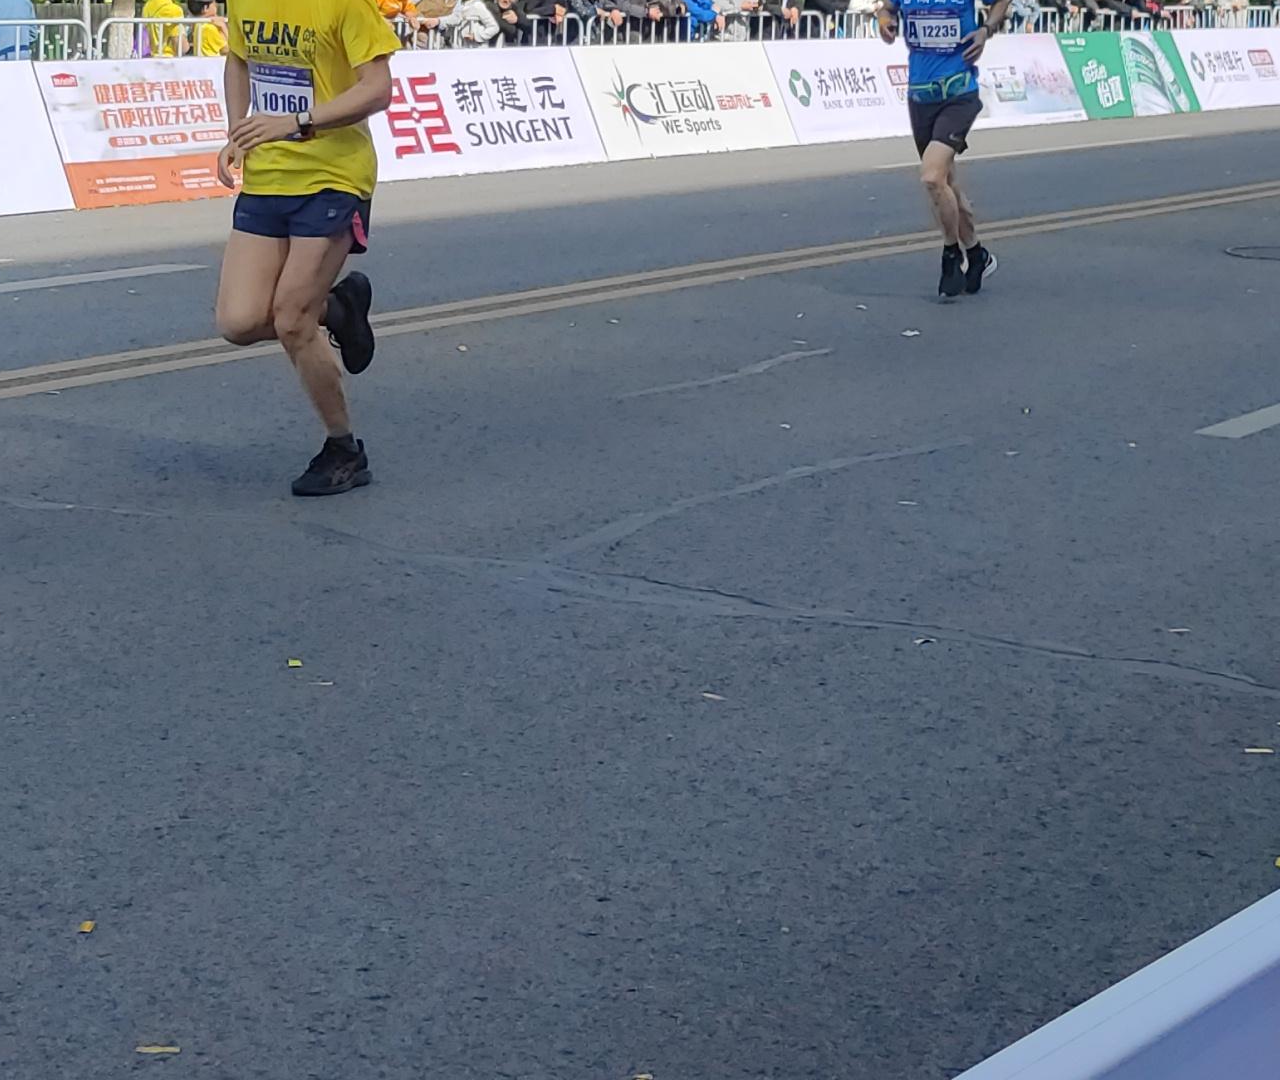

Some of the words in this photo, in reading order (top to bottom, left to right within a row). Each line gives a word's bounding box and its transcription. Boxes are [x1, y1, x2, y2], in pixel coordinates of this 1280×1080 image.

[242, 19, 301, 49] RUN
[908, 21, 918, 39] A
[923, 24, 957, 38] 12235
[451, 76, 567, 116] 新建元
[648, 79, 715, 114] 汇运动
[814, 67, 878, 97] 苏州银行
[262, 90, 308, 114] 10160
[466, 117, 575, 147] SUNGENT
[661, 120, 683, 135] WE
[686, 117, 722, 136] Sports
